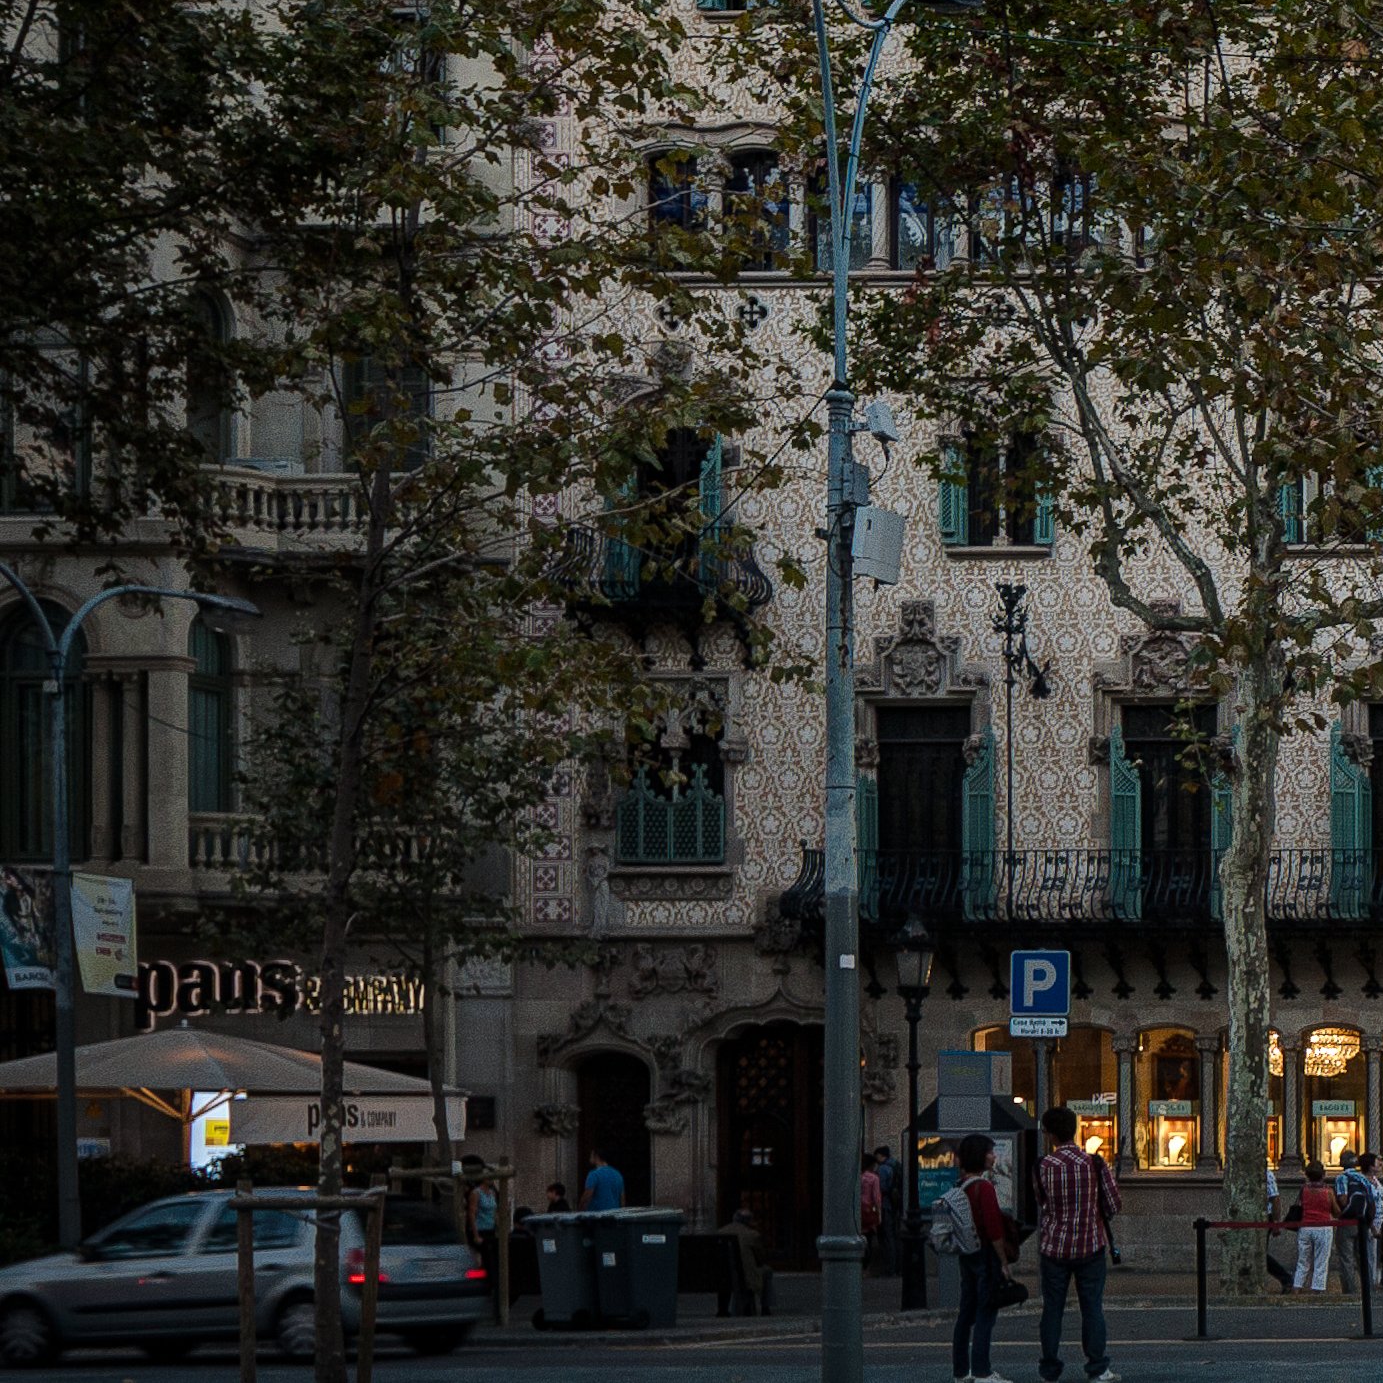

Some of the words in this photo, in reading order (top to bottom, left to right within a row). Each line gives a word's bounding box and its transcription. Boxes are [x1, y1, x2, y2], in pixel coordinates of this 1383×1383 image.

[1023, 958, 1057, 1007] P
[308, 1103, 358, 1136] pns
[367, 1109, 397, 1129] COMPANY
